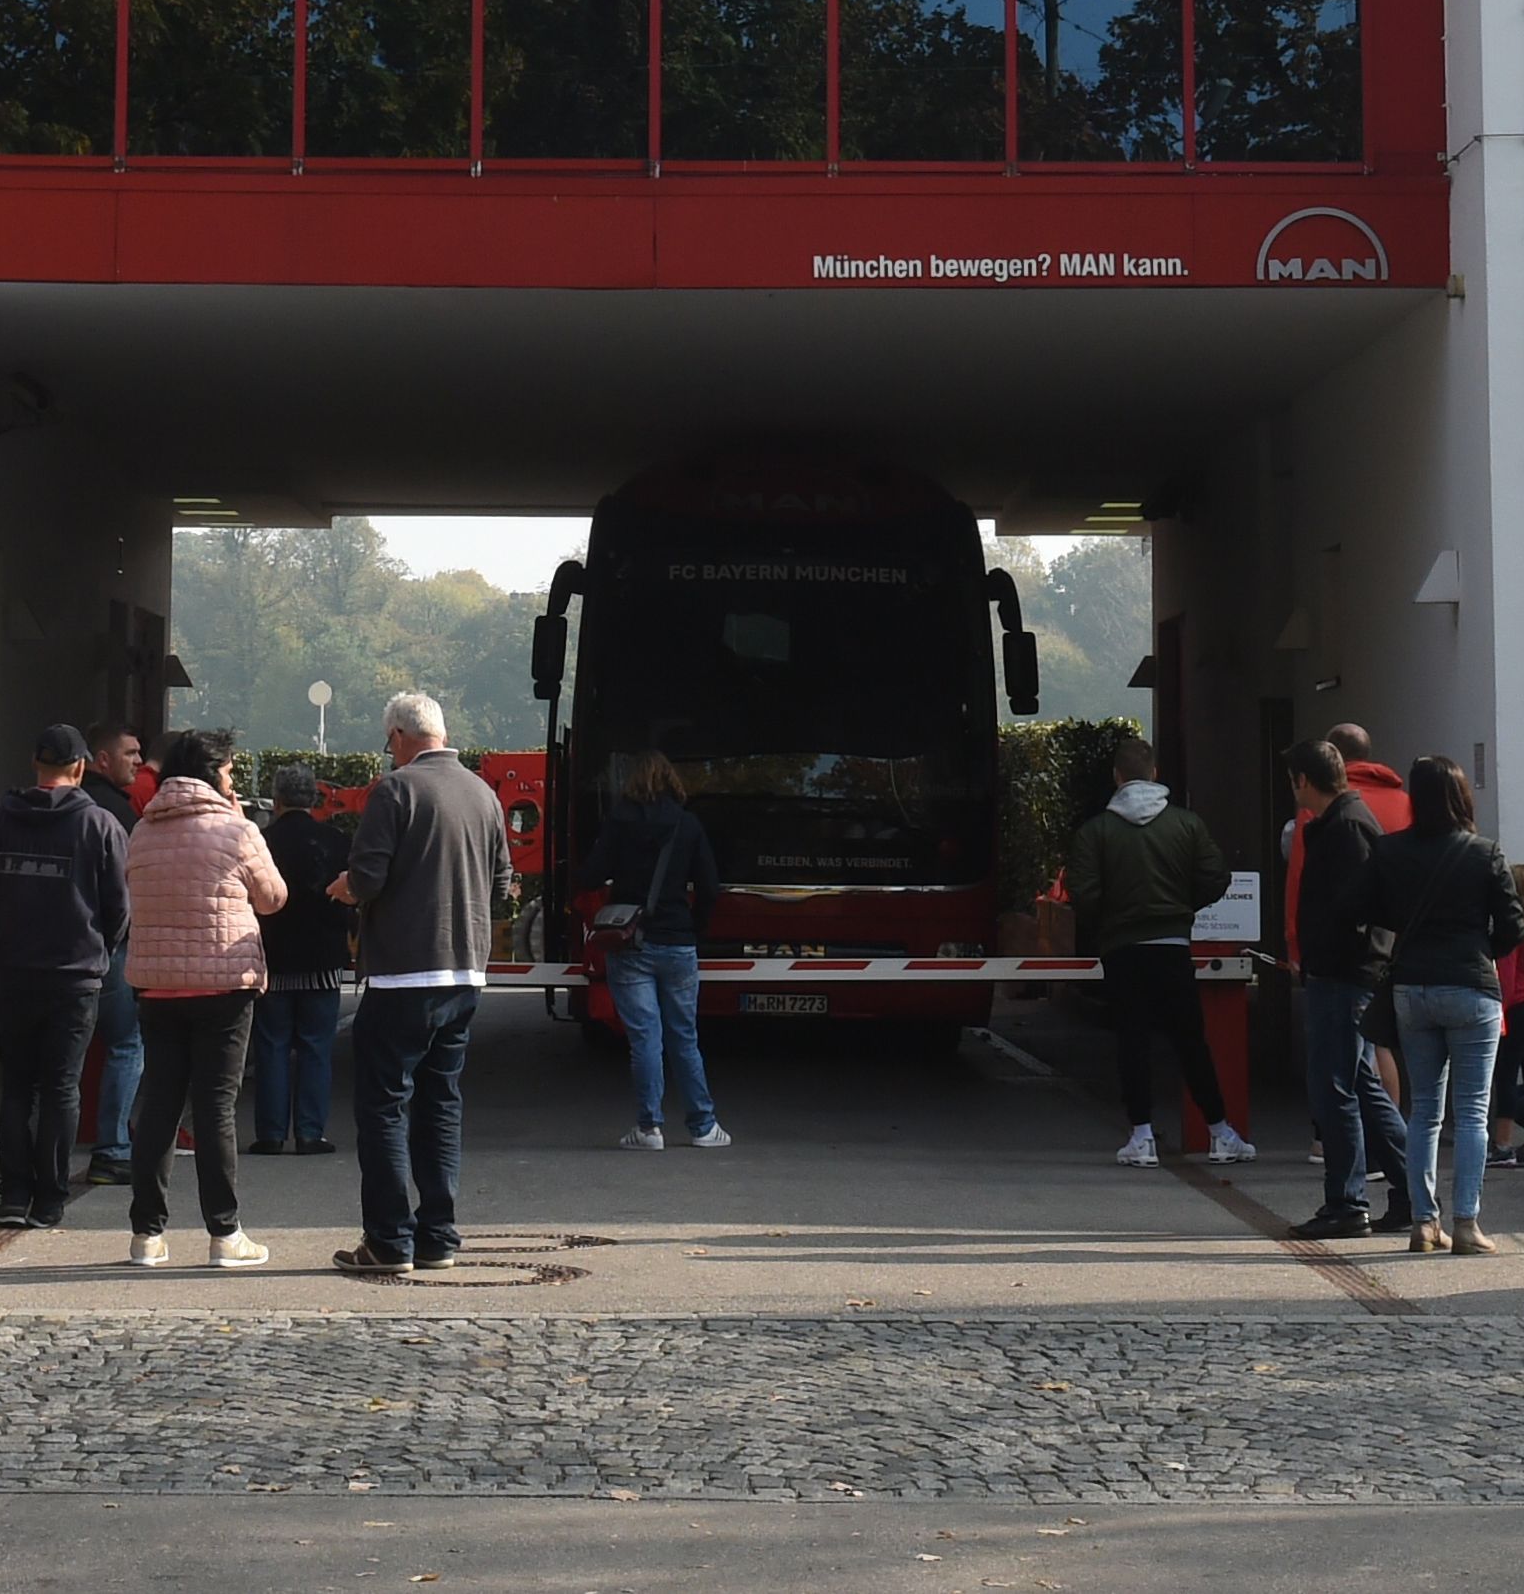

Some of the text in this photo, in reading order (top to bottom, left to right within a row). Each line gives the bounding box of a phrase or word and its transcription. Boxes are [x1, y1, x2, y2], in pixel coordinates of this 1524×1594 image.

[813, 254, 1189, 283] München bewegen? MAN kann.
[1268, 258, 1378, 281] MAN
[668, 564, 908, 584] FC BAYERN MÜNCHEN
[816, 856, 843, 868] WAS
[845, 856, 914, 869] VERBINDET.
[743, 943, 826, 957] MAN
[789, 997, 826, 1012] 7273
